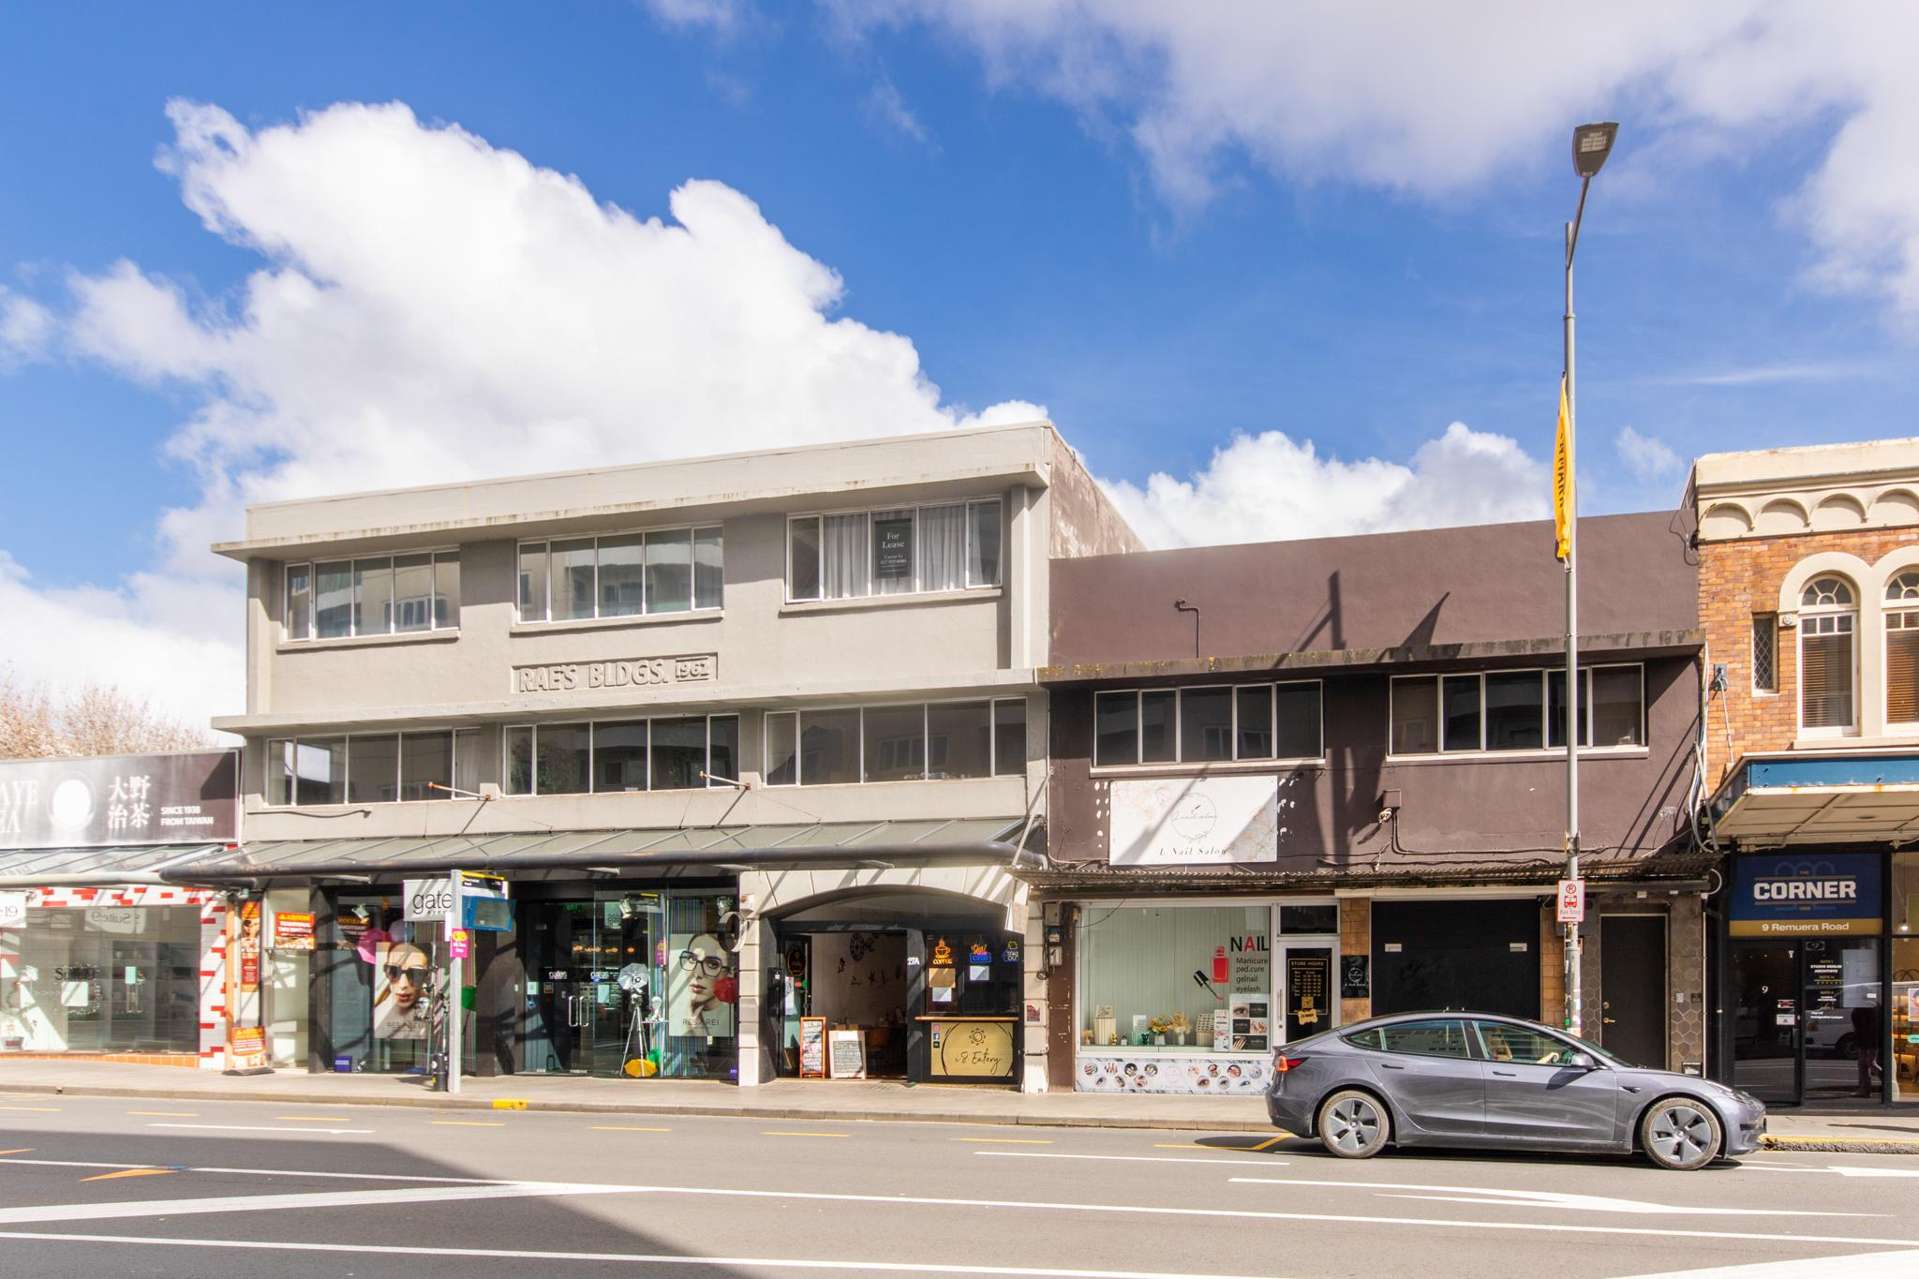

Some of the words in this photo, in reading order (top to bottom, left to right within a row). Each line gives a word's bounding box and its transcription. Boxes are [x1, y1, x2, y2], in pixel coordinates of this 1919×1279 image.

[887, 532, 899, 541] For
[882, 541, 904, 550] Lease
[589, 661, 669, 689] BLDGS.
[160, 817, 184, 826] FROM
[184, 816, 214, 825] TAIWAN
[1171, 847, 1193, 857] Nail
[1198, 846, 1227, 857] Salon
[1753, 880, 1857, 900] CORNER
[1762, 923, 1769, 931] 9
[1771, 922, 1820, 931] Remuera
[1821, 922, 1850, 931] Road
[1230, 936, 1269, 952] NAIL
[1236, 957, 1268, 965] Manicure
[1236, 966, 1265, 974] pedcure
[1236, 985, 1262, 994] eyelash
[971, 1047, 1003, 1075] Eatery
